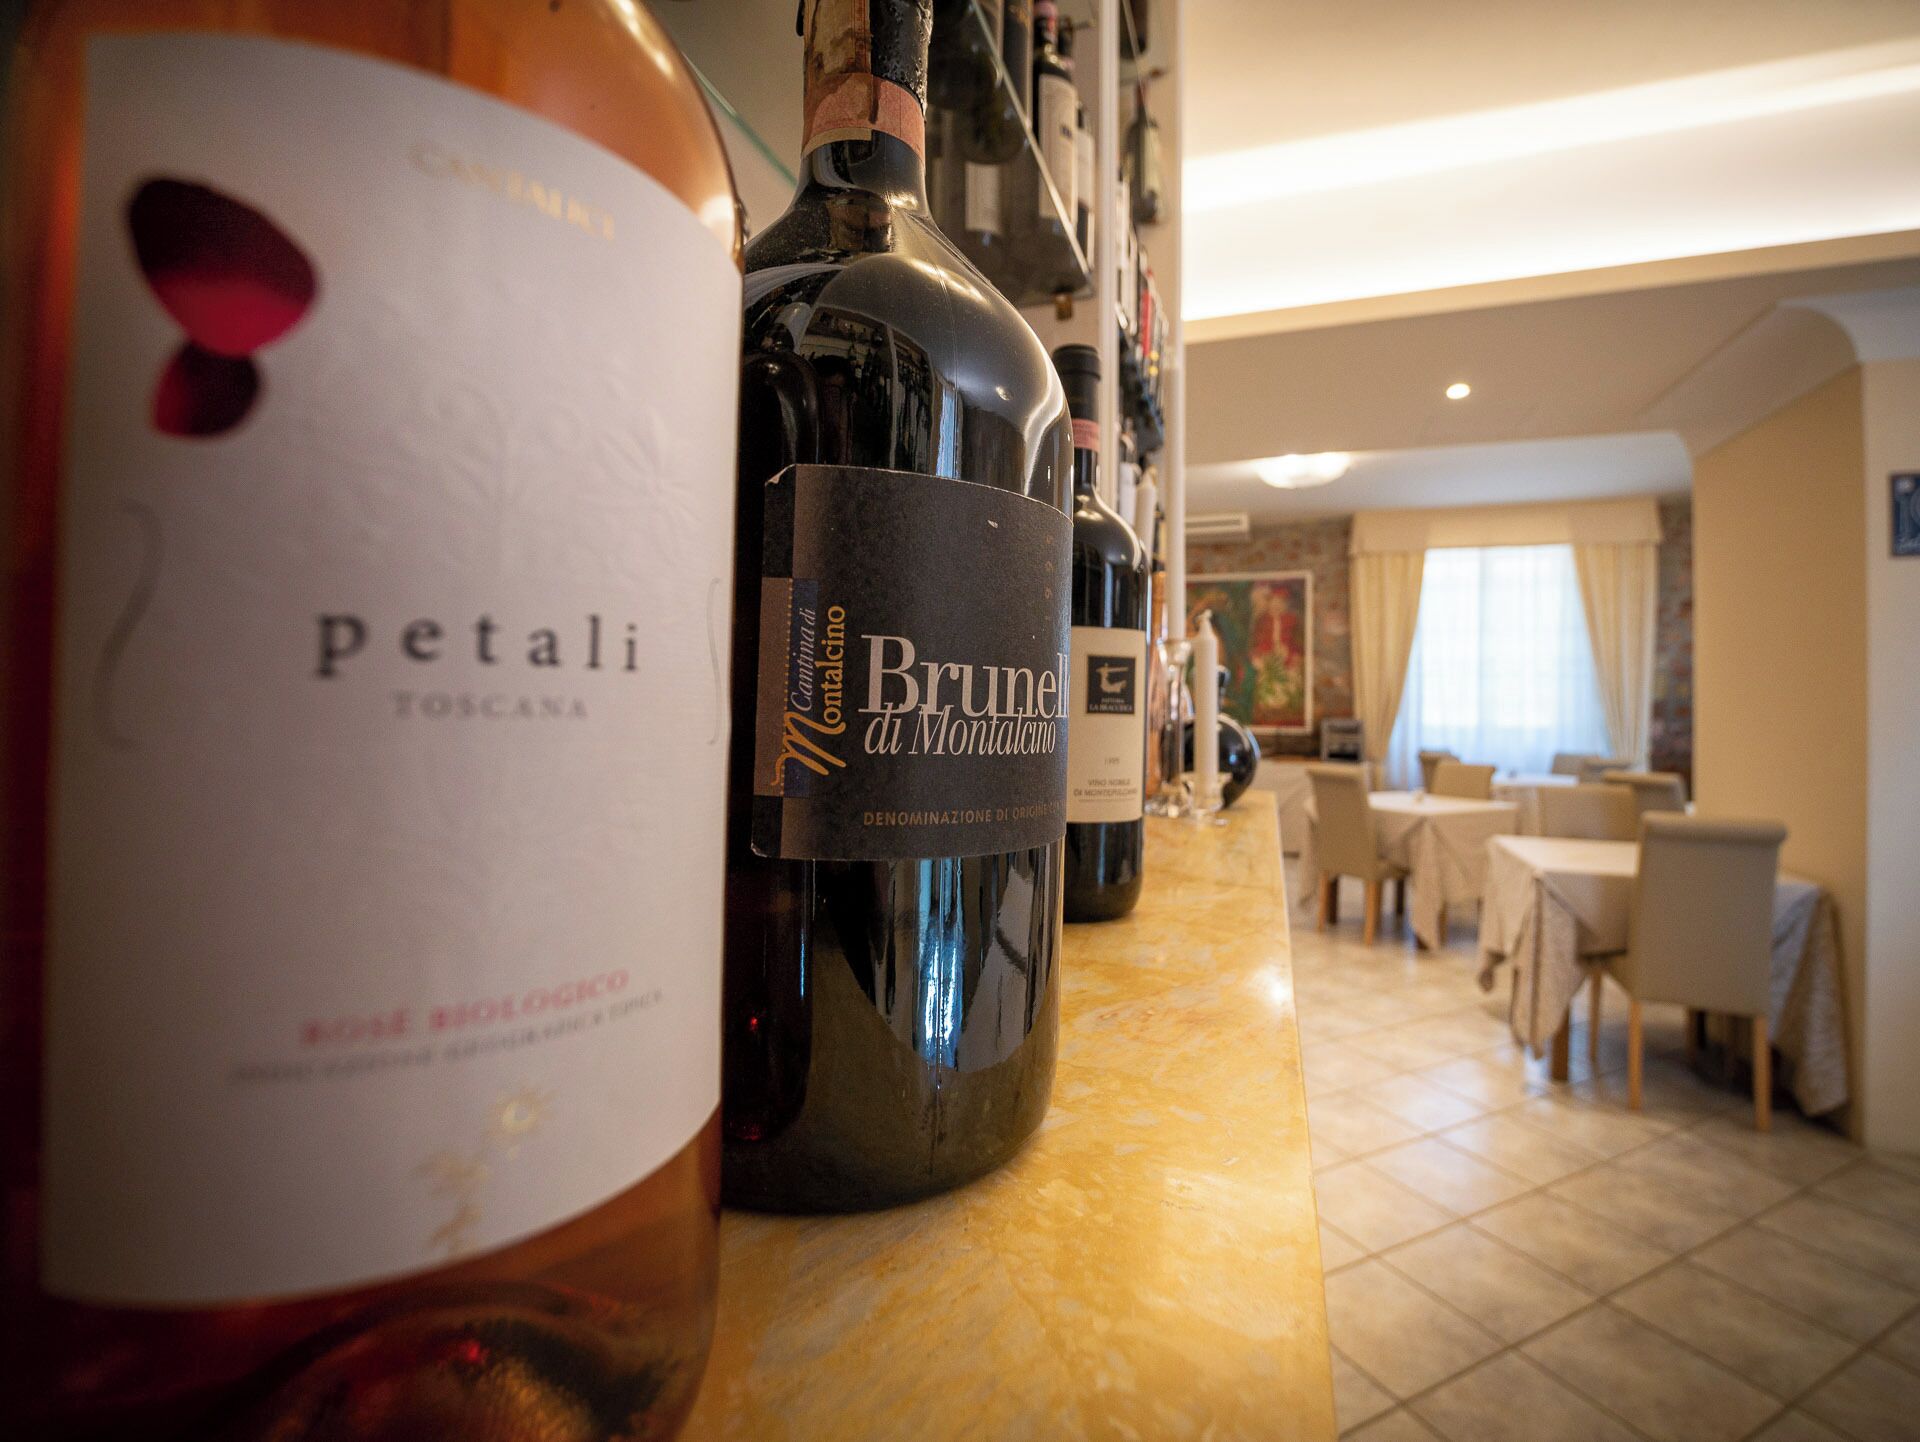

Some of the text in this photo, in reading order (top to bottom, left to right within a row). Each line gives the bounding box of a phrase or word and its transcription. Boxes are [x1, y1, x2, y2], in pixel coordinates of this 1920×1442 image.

[315, 613, 638, 679] petali
[791, 607, 816, 712] Cantina di
[393, 690, 588, 719] TOSCANA
[771, 605, 847, 786] Montalcino
[864, 703, 1056, 756] di Montalcino
[863, 809, 992, 826] DENOMINAZIONE
[996, 807, 1008, 821] DI
[429, 969, 630, 1032] BIOLOGICO
